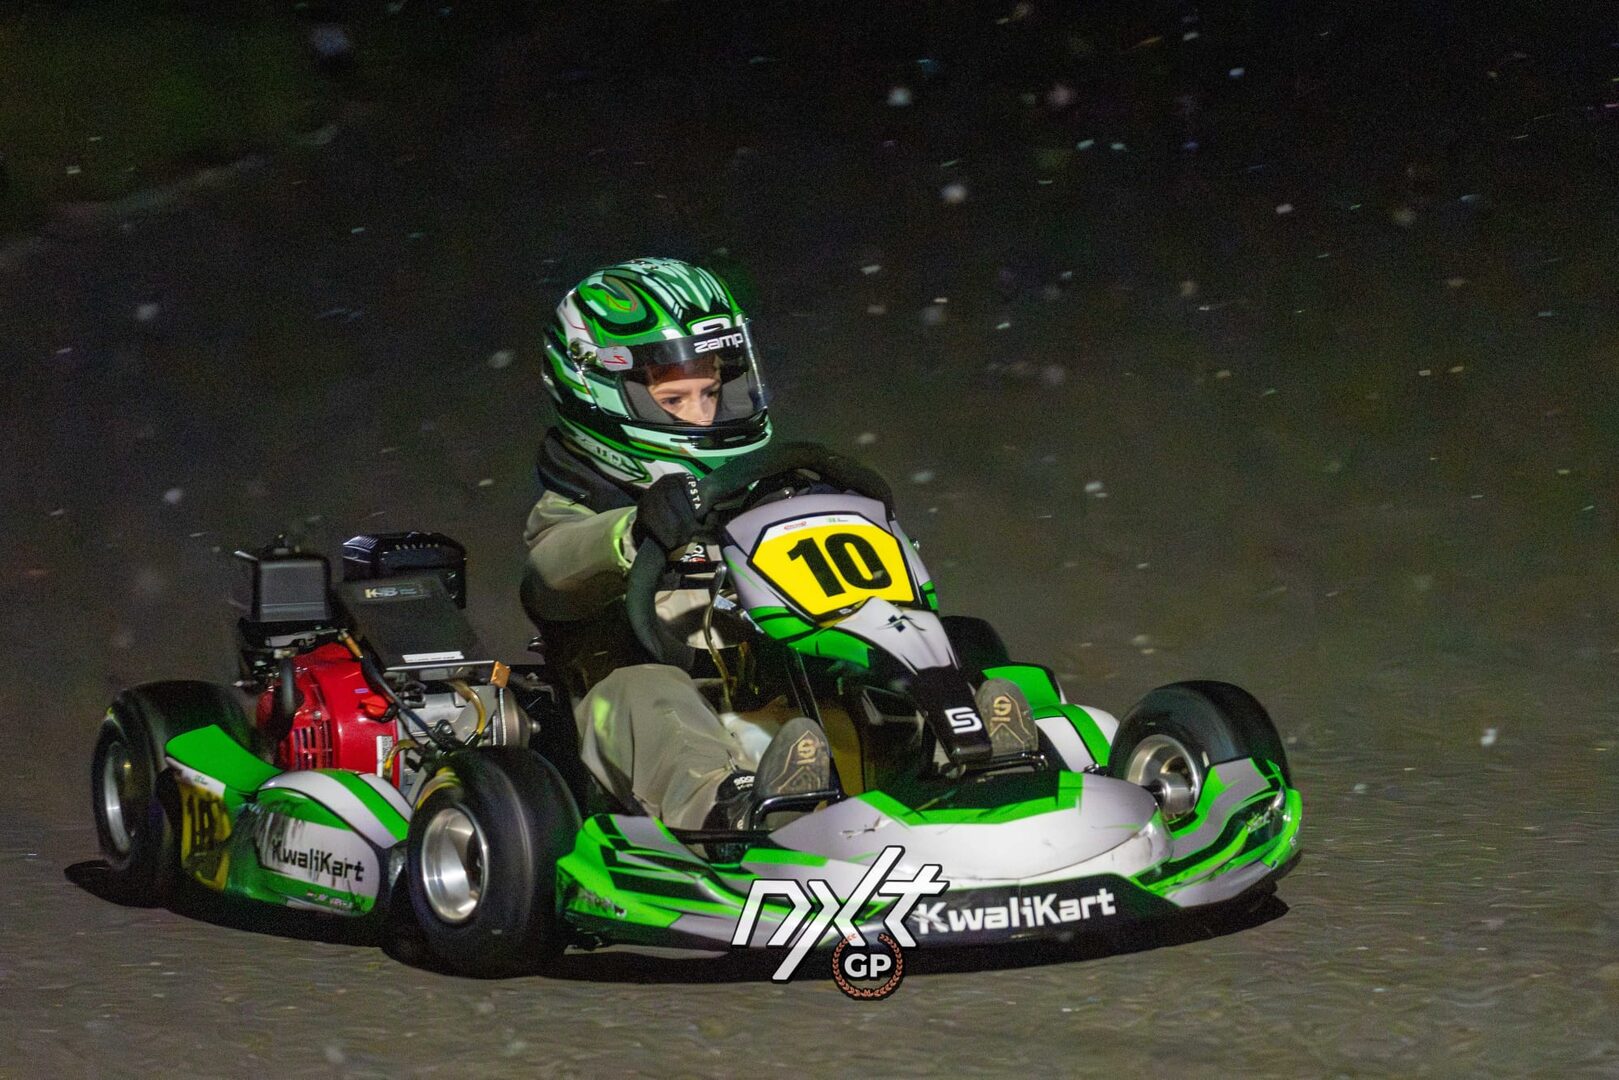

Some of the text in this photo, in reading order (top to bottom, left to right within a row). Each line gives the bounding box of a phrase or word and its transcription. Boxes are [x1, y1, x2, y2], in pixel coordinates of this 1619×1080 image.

[693, 332, 744, 354] zamp
[787, 533, 892, 598] 10
[271, 839, 365, 882] KwaliKart
[917, 888, 1116, 935] KwaliKart
